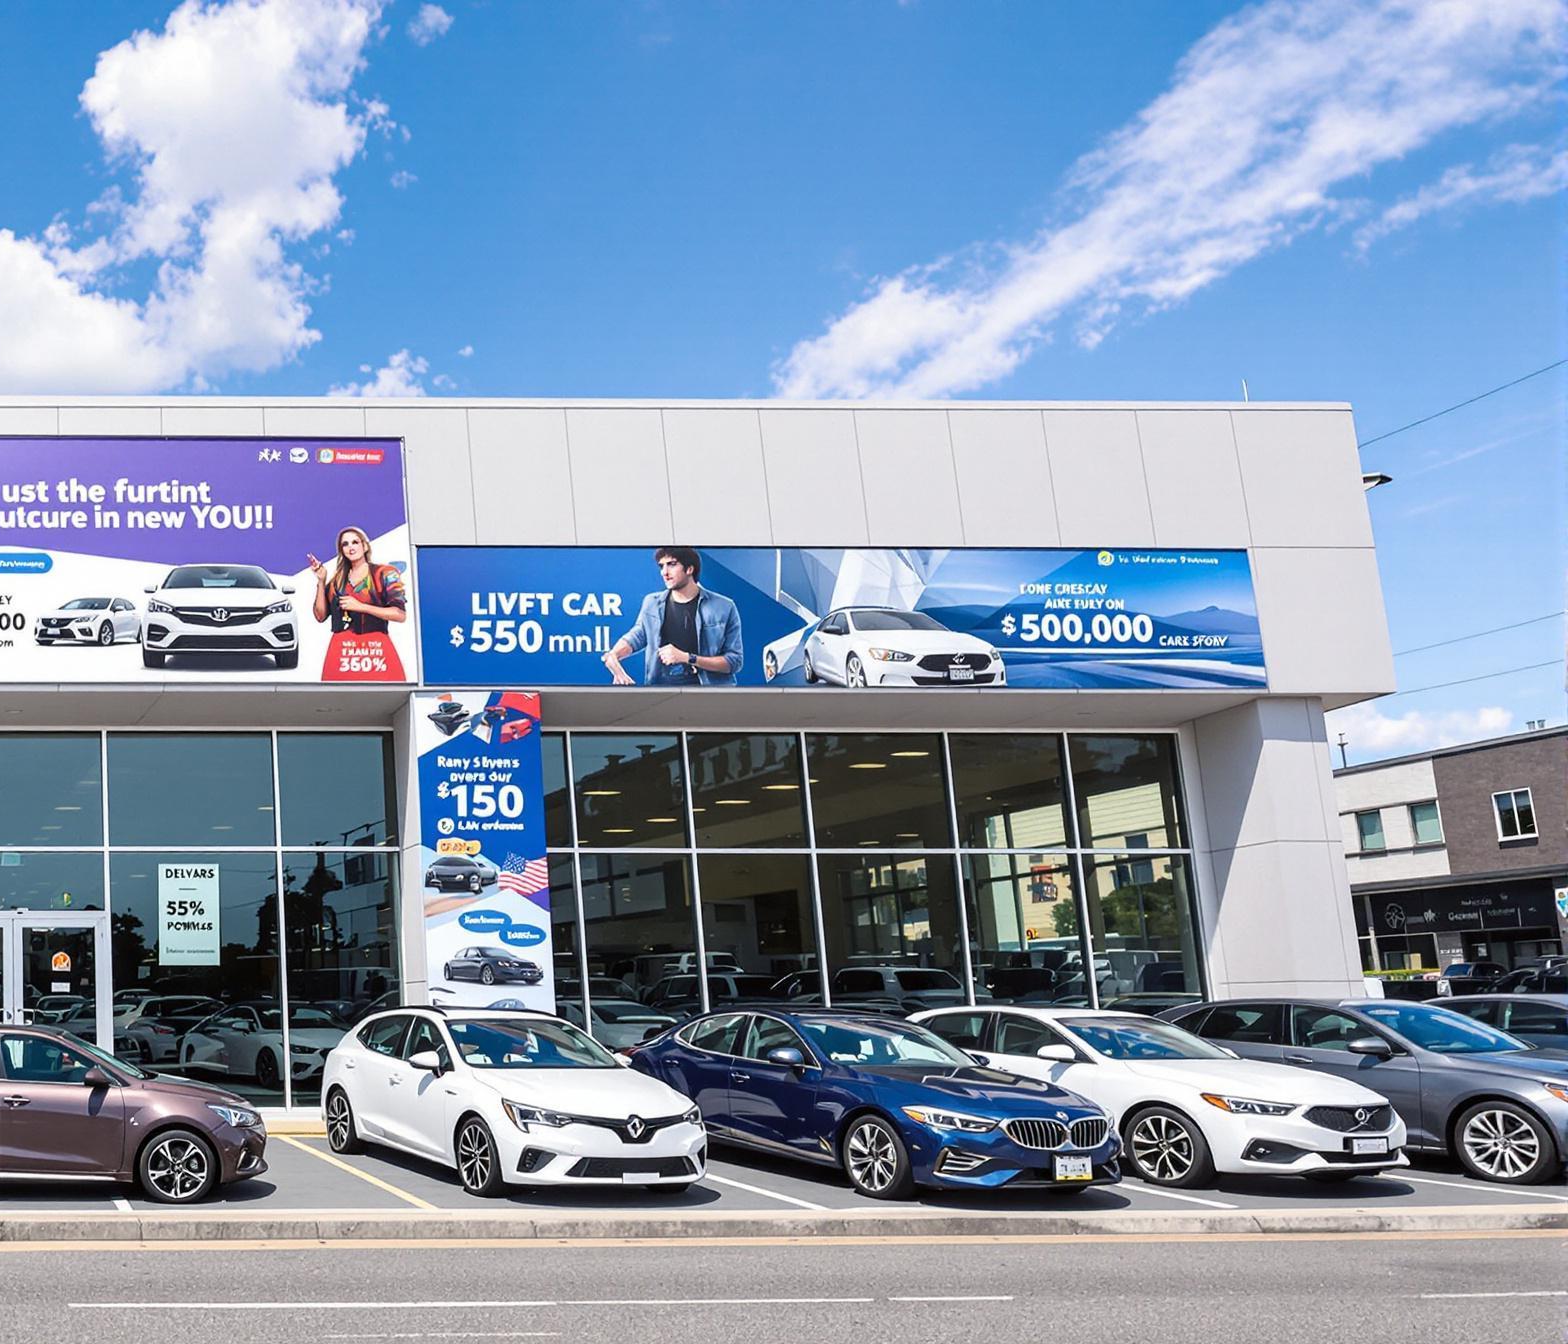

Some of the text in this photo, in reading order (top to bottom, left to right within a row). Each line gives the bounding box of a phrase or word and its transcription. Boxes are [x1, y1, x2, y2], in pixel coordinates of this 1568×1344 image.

[2, 480, 49, 504] ust
[56, 477, 106, 503] the
[114, 477, 211, 504] furtint
[95, 504, 120, 529] in
[127, 511, 186, 529] new
[191, 504, 273, 530] YOU!!
[471, 592, 623, 616] LIVFT CAR
[437, 782, 524, 818] $150
[166, 901, 205, 916] 55%
